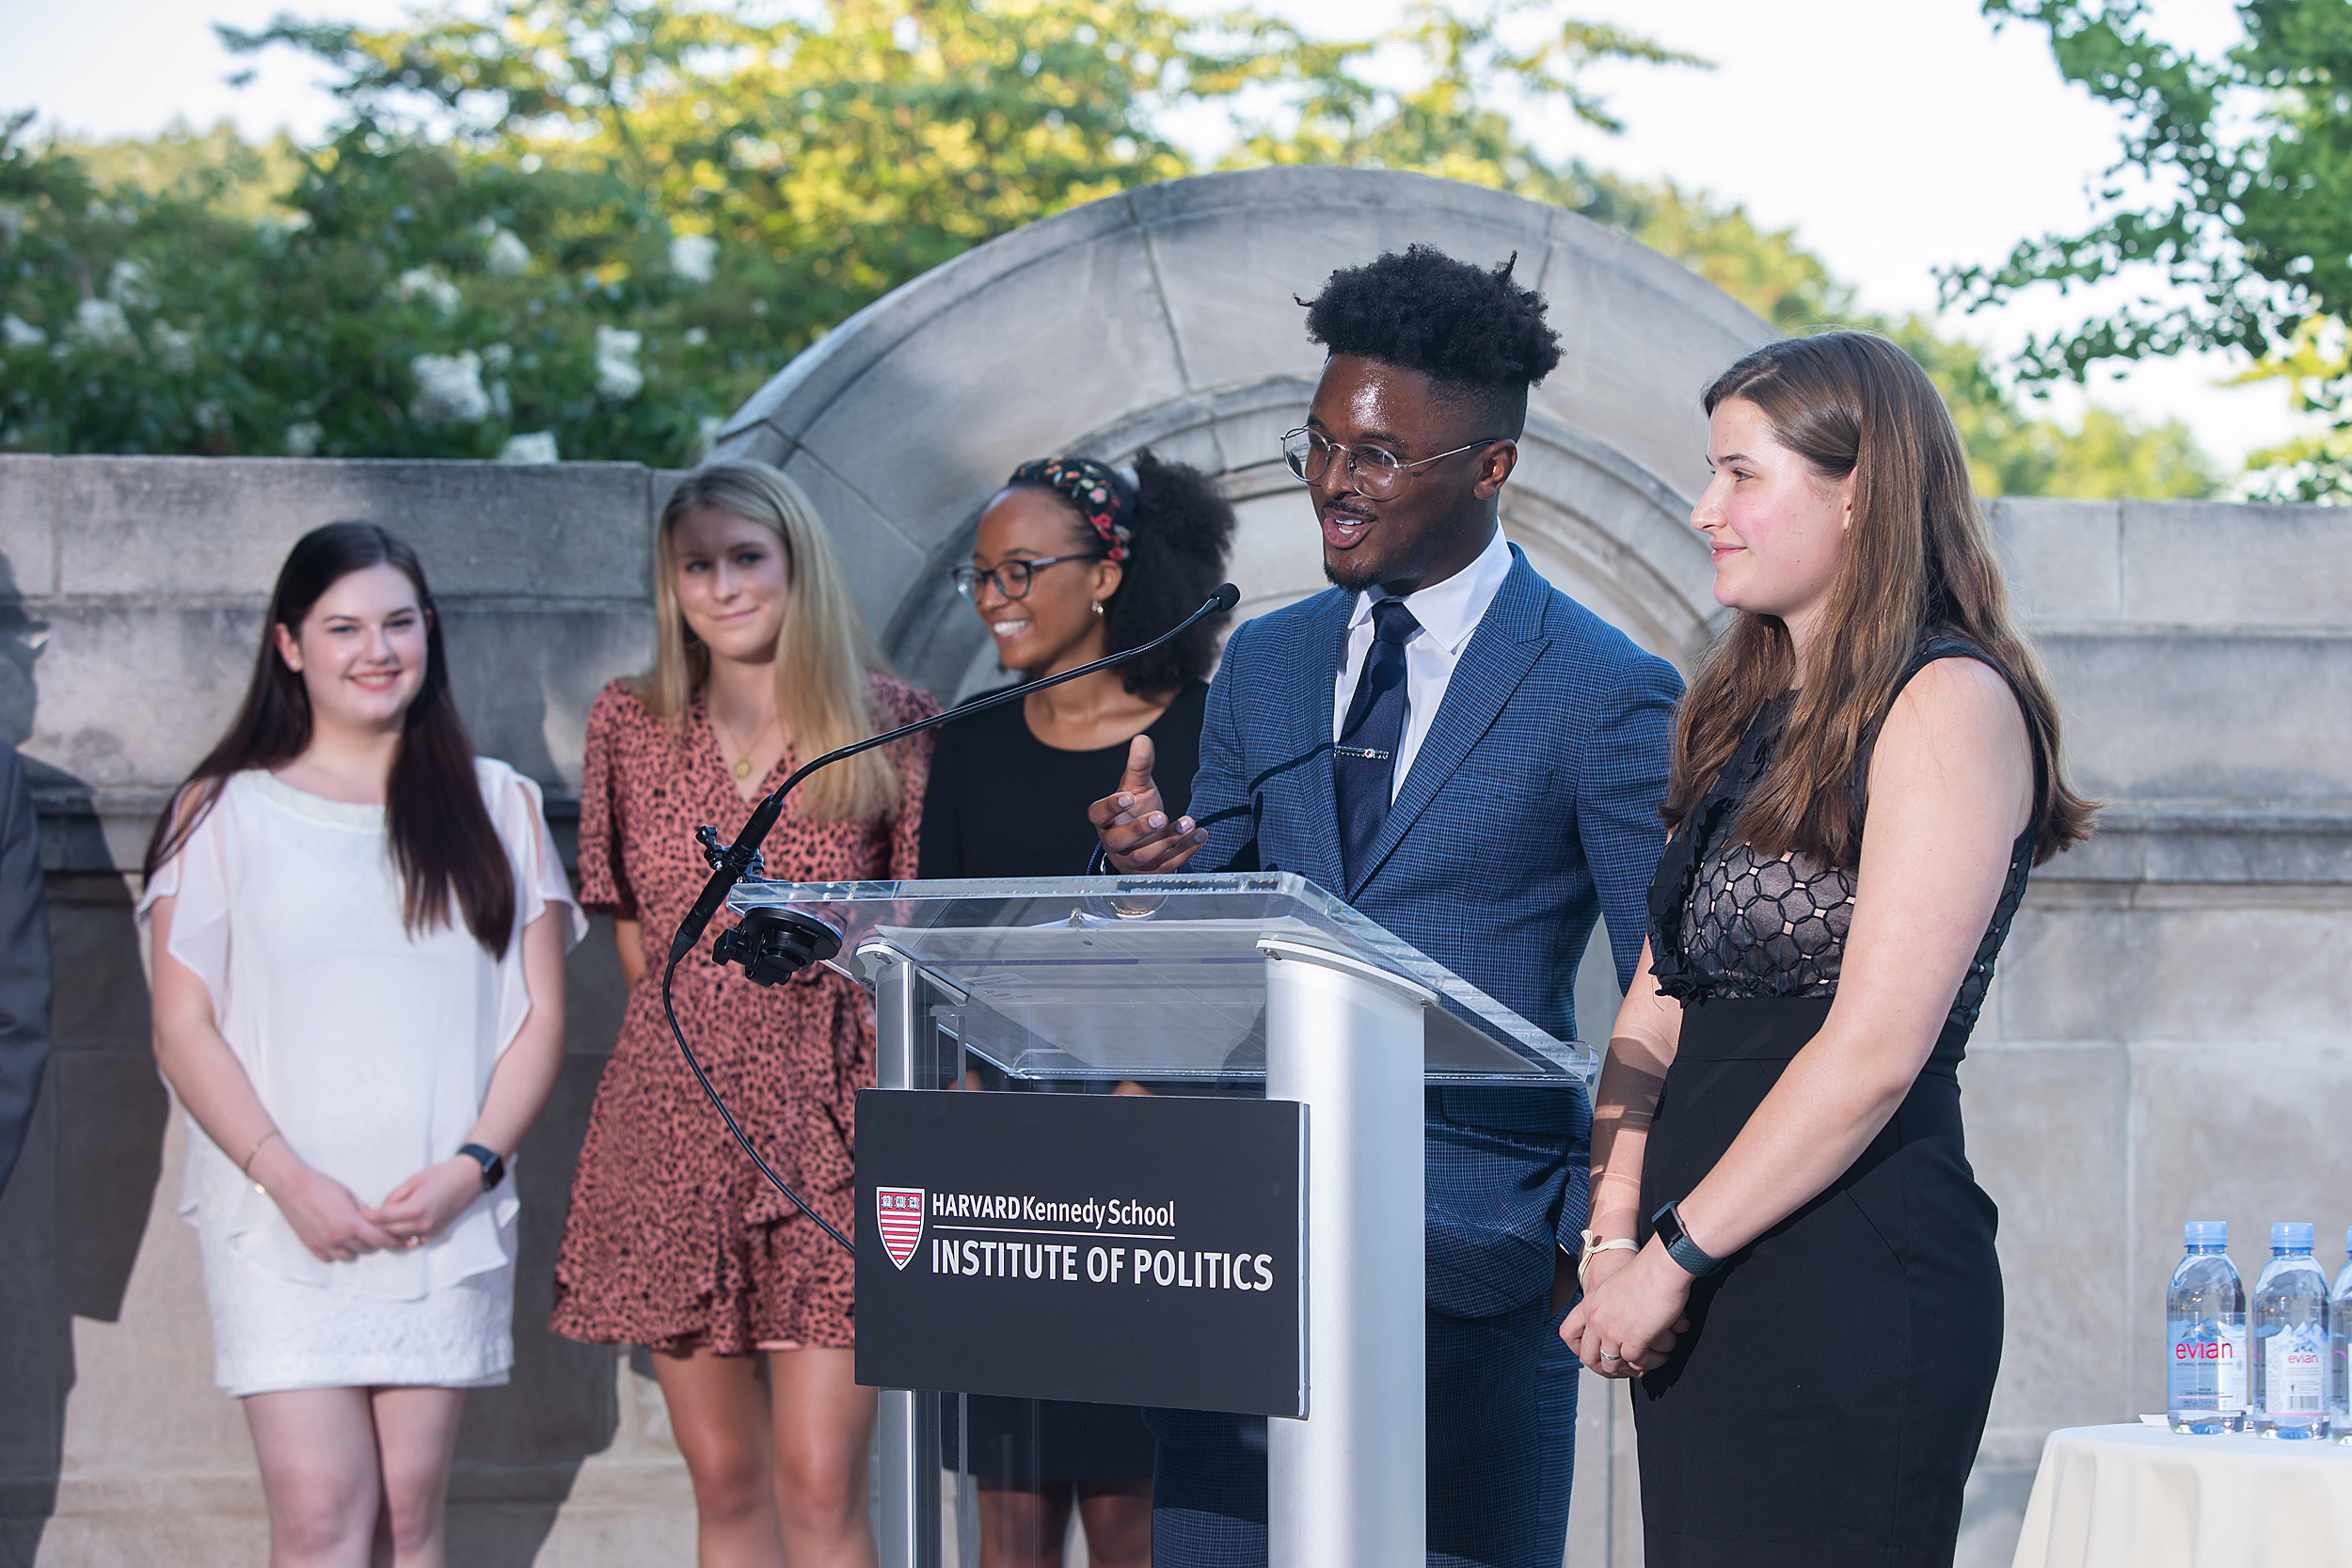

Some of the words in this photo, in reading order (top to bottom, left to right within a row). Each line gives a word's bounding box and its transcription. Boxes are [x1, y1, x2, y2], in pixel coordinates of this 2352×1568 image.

[932, 1193, 1021, 1220] HARVARD
[1023, 1196, 1106, 1230] Kennedy
[1107, 1198, 1176, 1227] School
[932, 1239, 1078, 1281] INSTITUTE
[1087, 1246, 1126, 1283] OF
[1134, 1248, 1274, 1291] POLITICS
[2175, 1339, 2233, 1359] evian
[2288, 1354, 2318, 1364] evian
